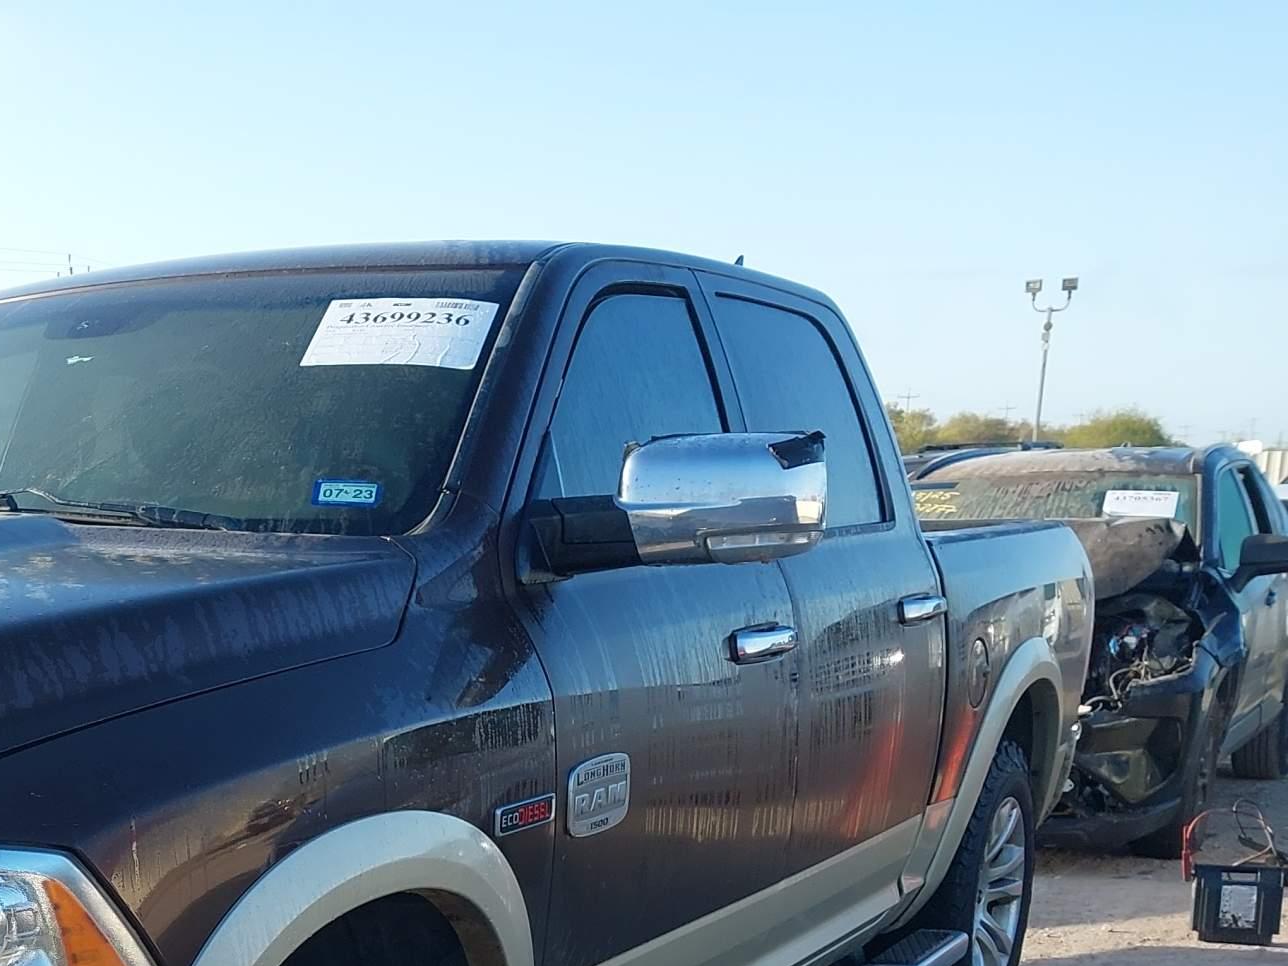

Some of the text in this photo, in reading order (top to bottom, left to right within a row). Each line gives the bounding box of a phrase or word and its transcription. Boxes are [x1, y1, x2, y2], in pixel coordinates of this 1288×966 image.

[339, 311, 471, 327] 43699236
[322, 488, 374, 500] 07 23
[575, 780, 628, 816] RAM
[501, 801, 550, 828] ECODIESEL
[589, 817, 610, 832] 1500
